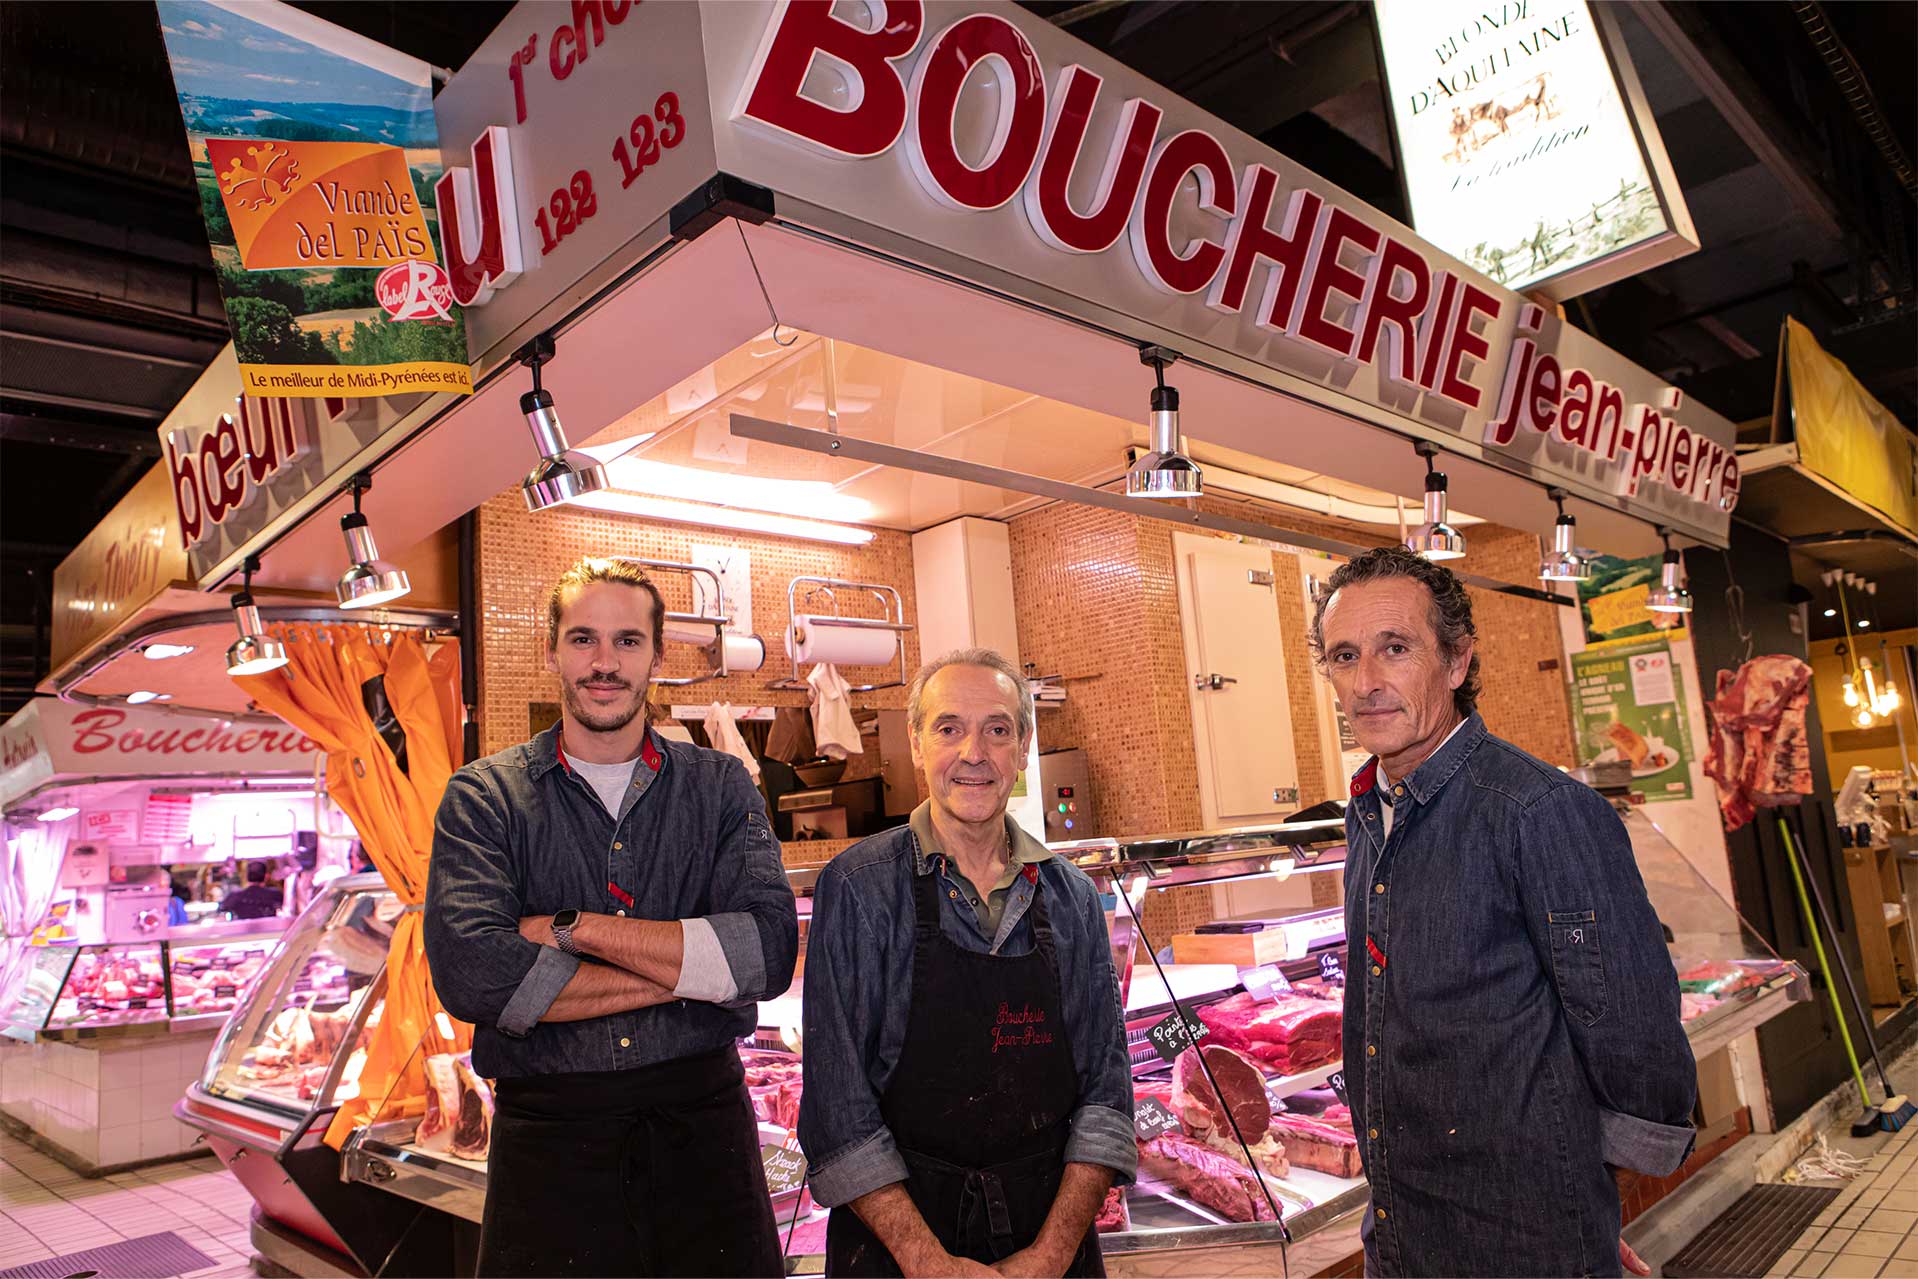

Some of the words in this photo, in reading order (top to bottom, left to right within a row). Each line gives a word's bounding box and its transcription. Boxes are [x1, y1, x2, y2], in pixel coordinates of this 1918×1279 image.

[1410, 11, 1580, 117] D'AQUITAINE
[313, 179, 415, 217] Viande
[534, 169, 598, 257] 122
[612, 91, 686, 190] 123
[743, 0, 1501, 409] BOUCHERIE
[295, 221, 345, 261] del
[249, 372, 267, 388] Le
[271, 372, 324, 389] meilleur
[328, 373, 345, 388] de
[347, 367, 441, 389] Midi-Pyrénées
[443, 372, 457, 385] est
[1493, 303, 1741, 513] jean-pierre
[991, 1026, 1055, 1054] Jean-Pierre
